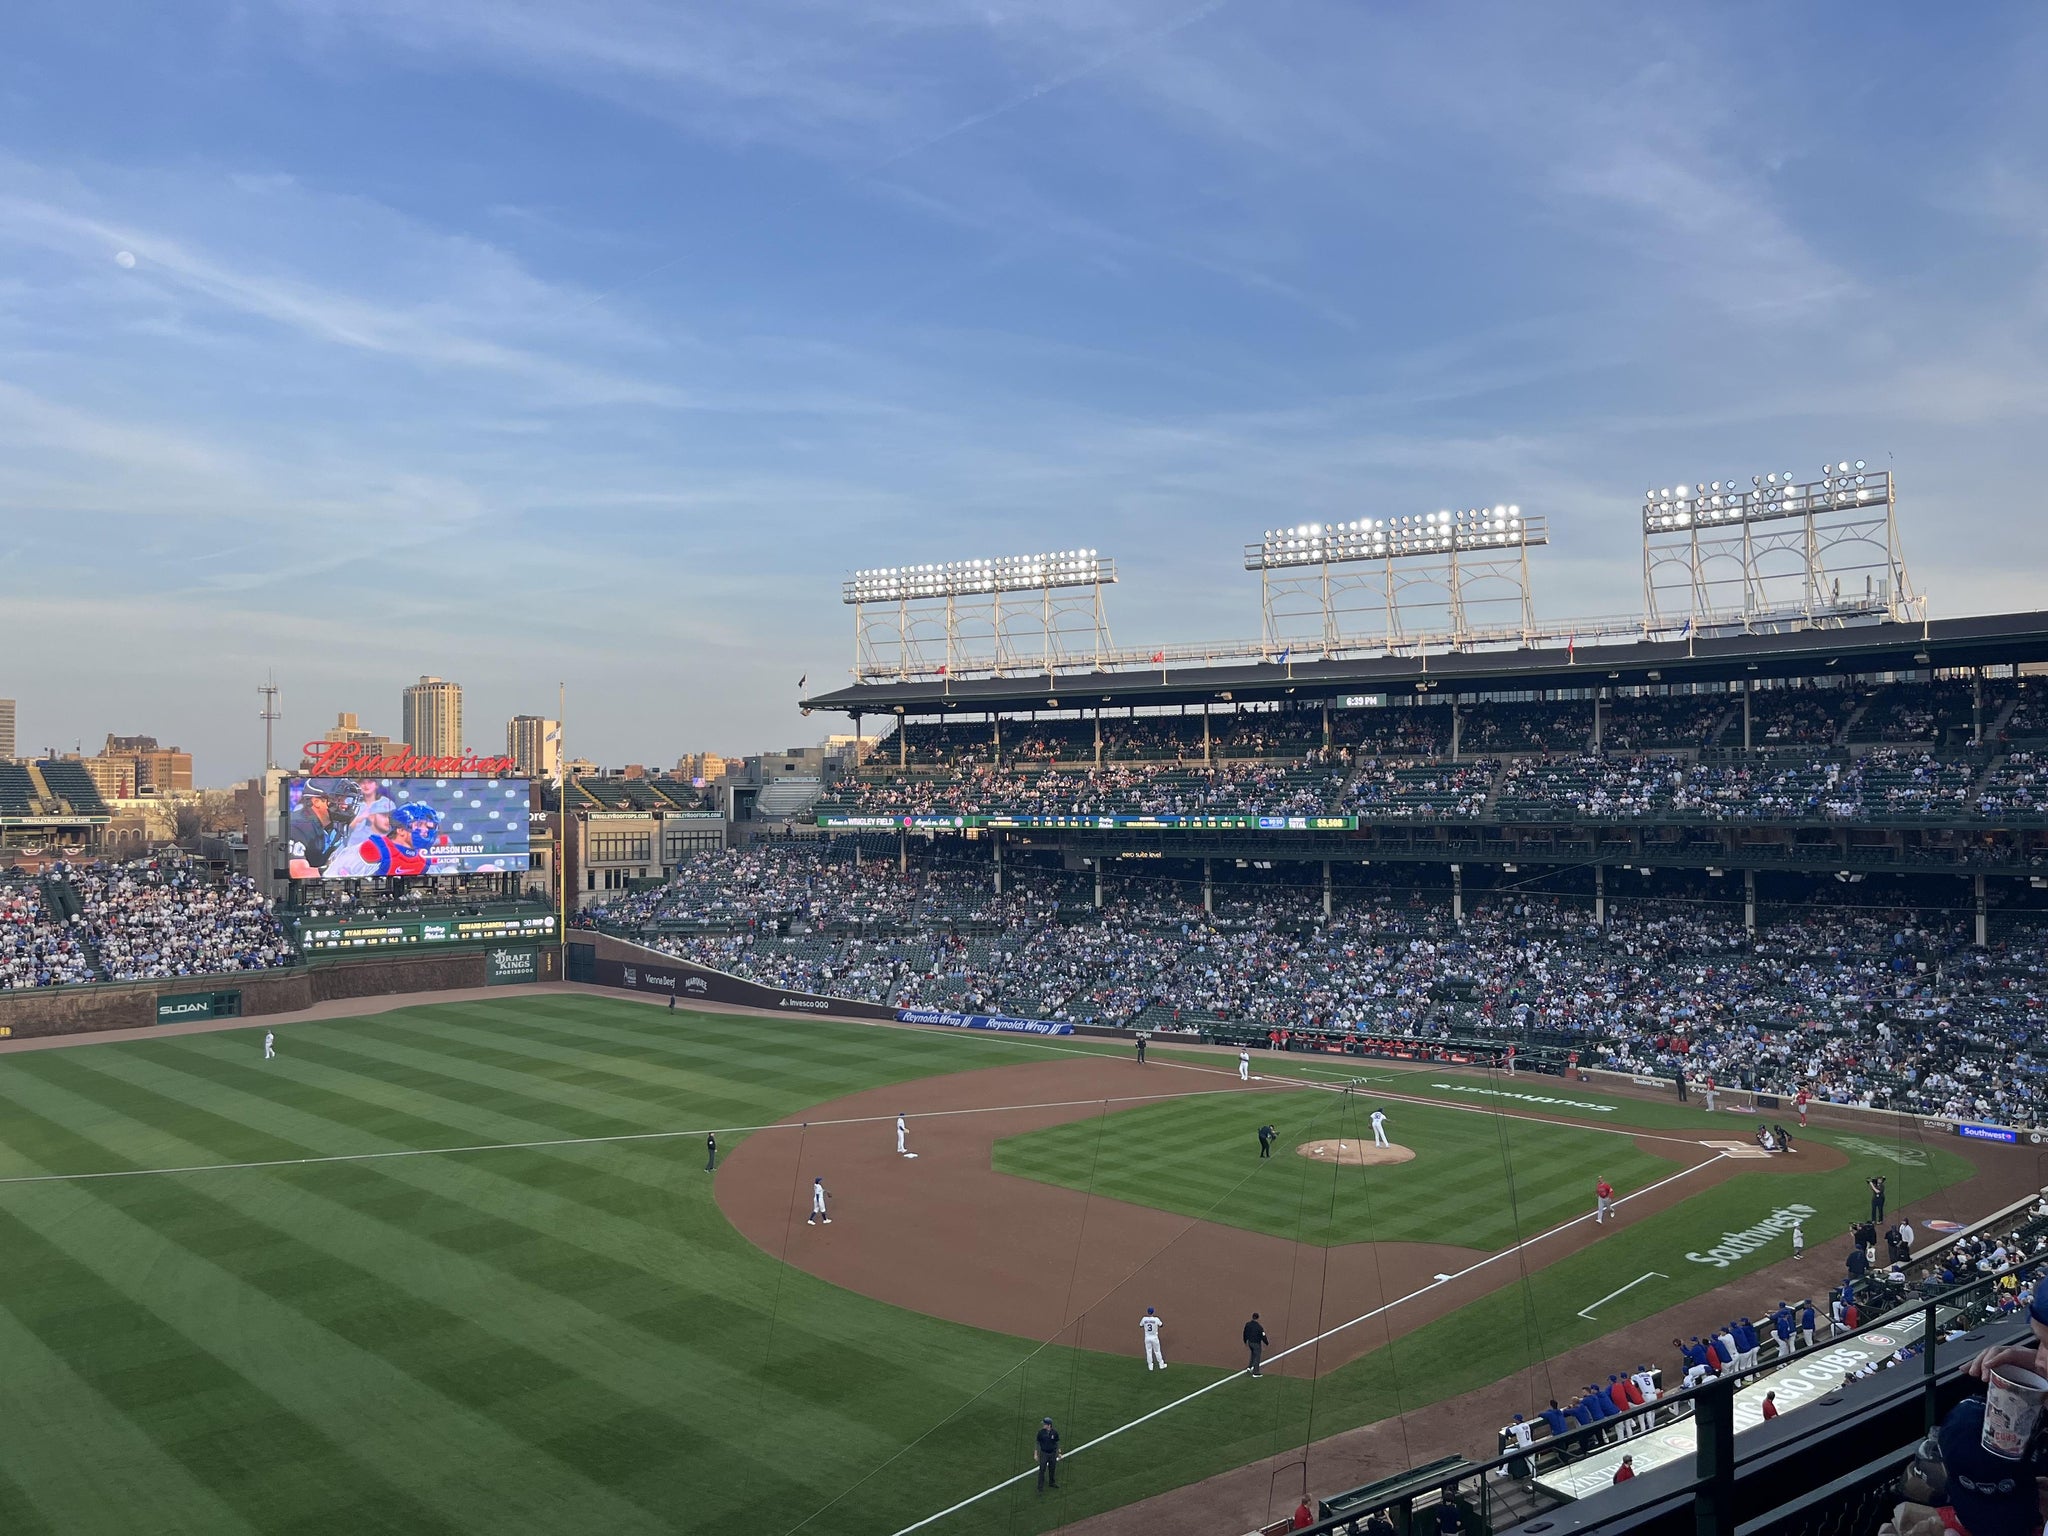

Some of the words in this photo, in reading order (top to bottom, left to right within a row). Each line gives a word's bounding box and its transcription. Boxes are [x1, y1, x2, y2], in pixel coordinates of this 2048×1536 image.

[1346, 696, 1364, 705] 6:39
[1365, 696, 1377, 705] PM
[303, 741, 515, 776] Budweiser
[848, 817, 875, 826] WRIGLEY
[876, 817, 895, 826] FIELD
[1289, 821, 1307, 829] TOTAL
[429, 845, 460, 854] CARSON
[460, 845, 484, 853] KELLY
[1135, 850, 1148, 858] suite
[495, 953, 531, 964] DRAFT
[500, 960, 530, 970] KINGS
[495, 968, 534, 976] SPORTSBOOK
[645, 973, 663, 985] Vienna
[662, 975, 676, 989] Beef
[685, 976, 708, 991] MARQUEE
[159, 1002, 208, 1015] SLOAN
[789, 998, 814, 1008] Invesco
[814, 1000, 829, 1009] QQQ
[902, 1011, 939, 1024] Reynolds
[939, 1014, 961, 1027] Wrap
[985, 1018, 1026, 1031] Reynolds
[1024, 1020, 1050, 1034] Wrap
[1964, 1127, 2005, 1140] Southwest
[1685, 1207, 1811, 1268] Southwest
[1147, 1323, 1153, 1332] 3
[1799, 1347, 1868, 1382] CUBS
[1643, 1377, 1651, 1386] 5
